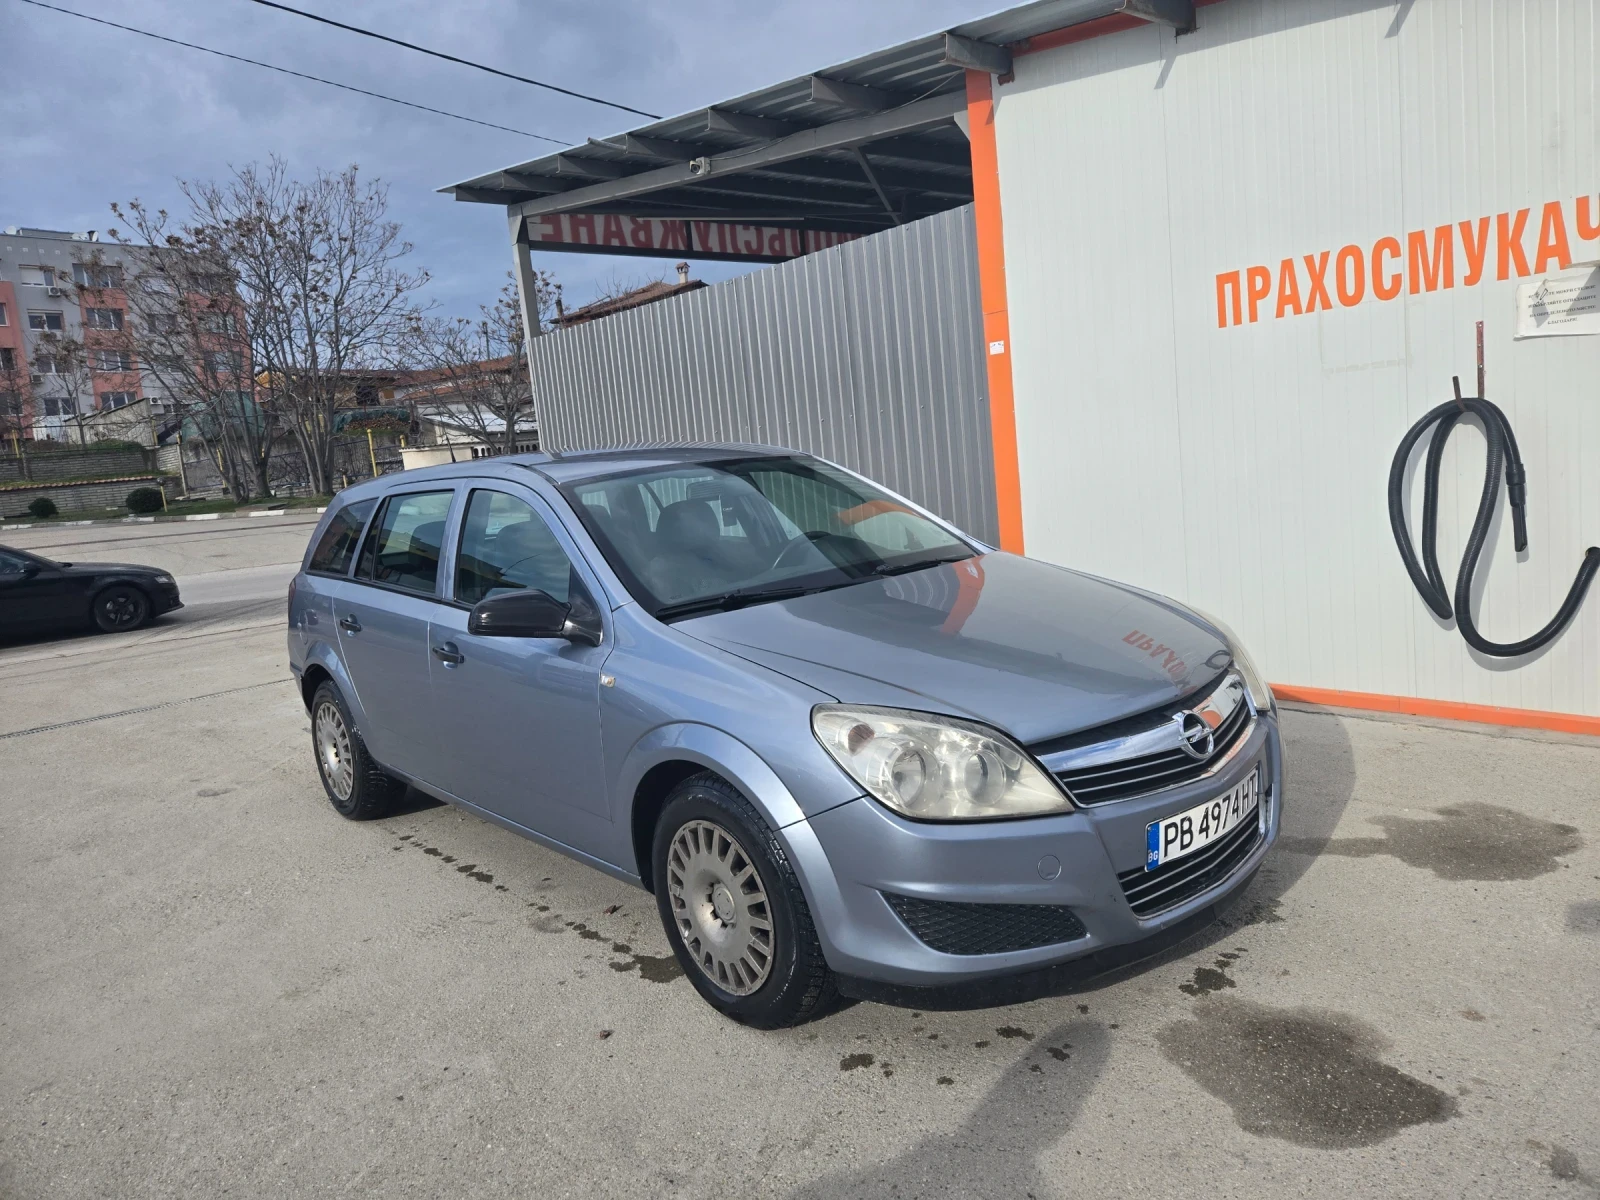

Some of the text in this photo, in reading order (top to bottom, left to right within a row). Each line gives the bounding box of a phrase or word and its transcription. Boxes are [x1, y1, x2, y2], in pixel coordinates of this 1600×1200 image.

[1215, 195, 1600, 328] ПРАХОСМУКАЧ
[1147, 849, 1159, 862] BG
[1164, 817, 1194, 858] PB
